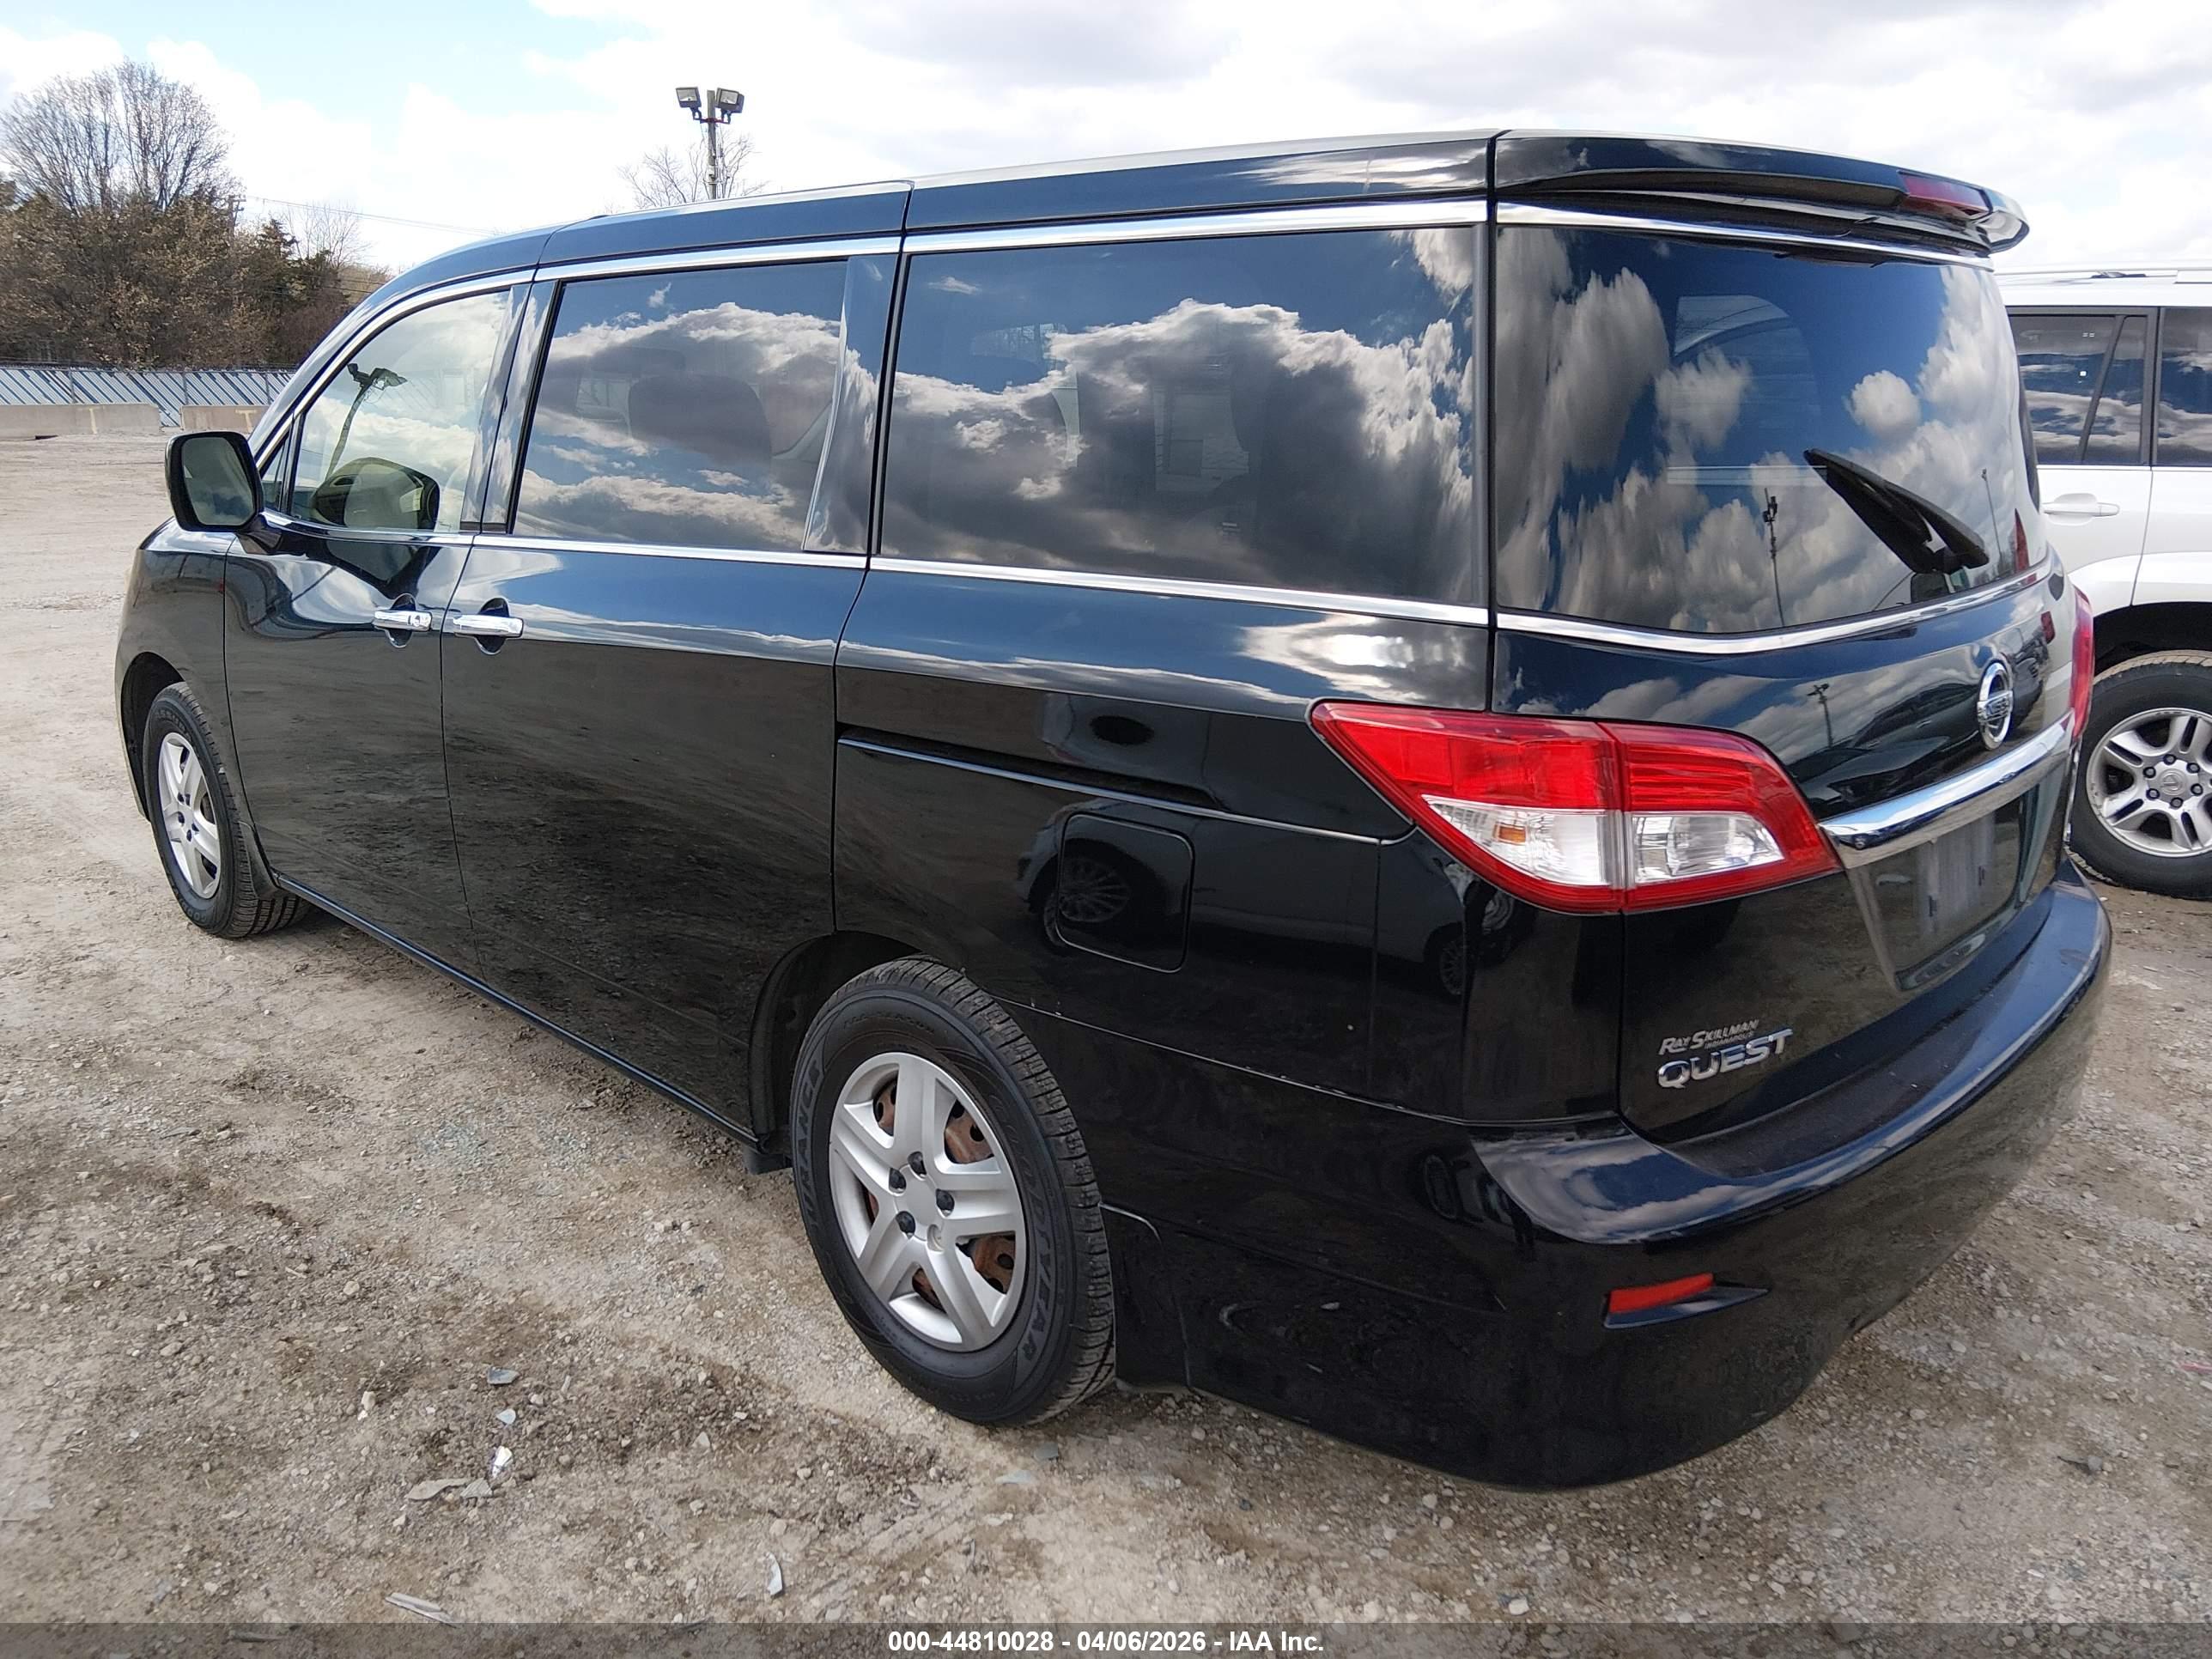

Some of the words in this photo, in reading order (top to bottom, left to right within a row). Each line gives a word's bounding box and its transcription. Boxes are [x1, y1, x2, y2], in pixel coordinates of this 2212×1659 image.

[1658, 1036, 1691, 1055] RAY
[1690, 1019, 1759, 1049] SKILLMAN
[1658, 1028, 1794, 1090] QUEST
